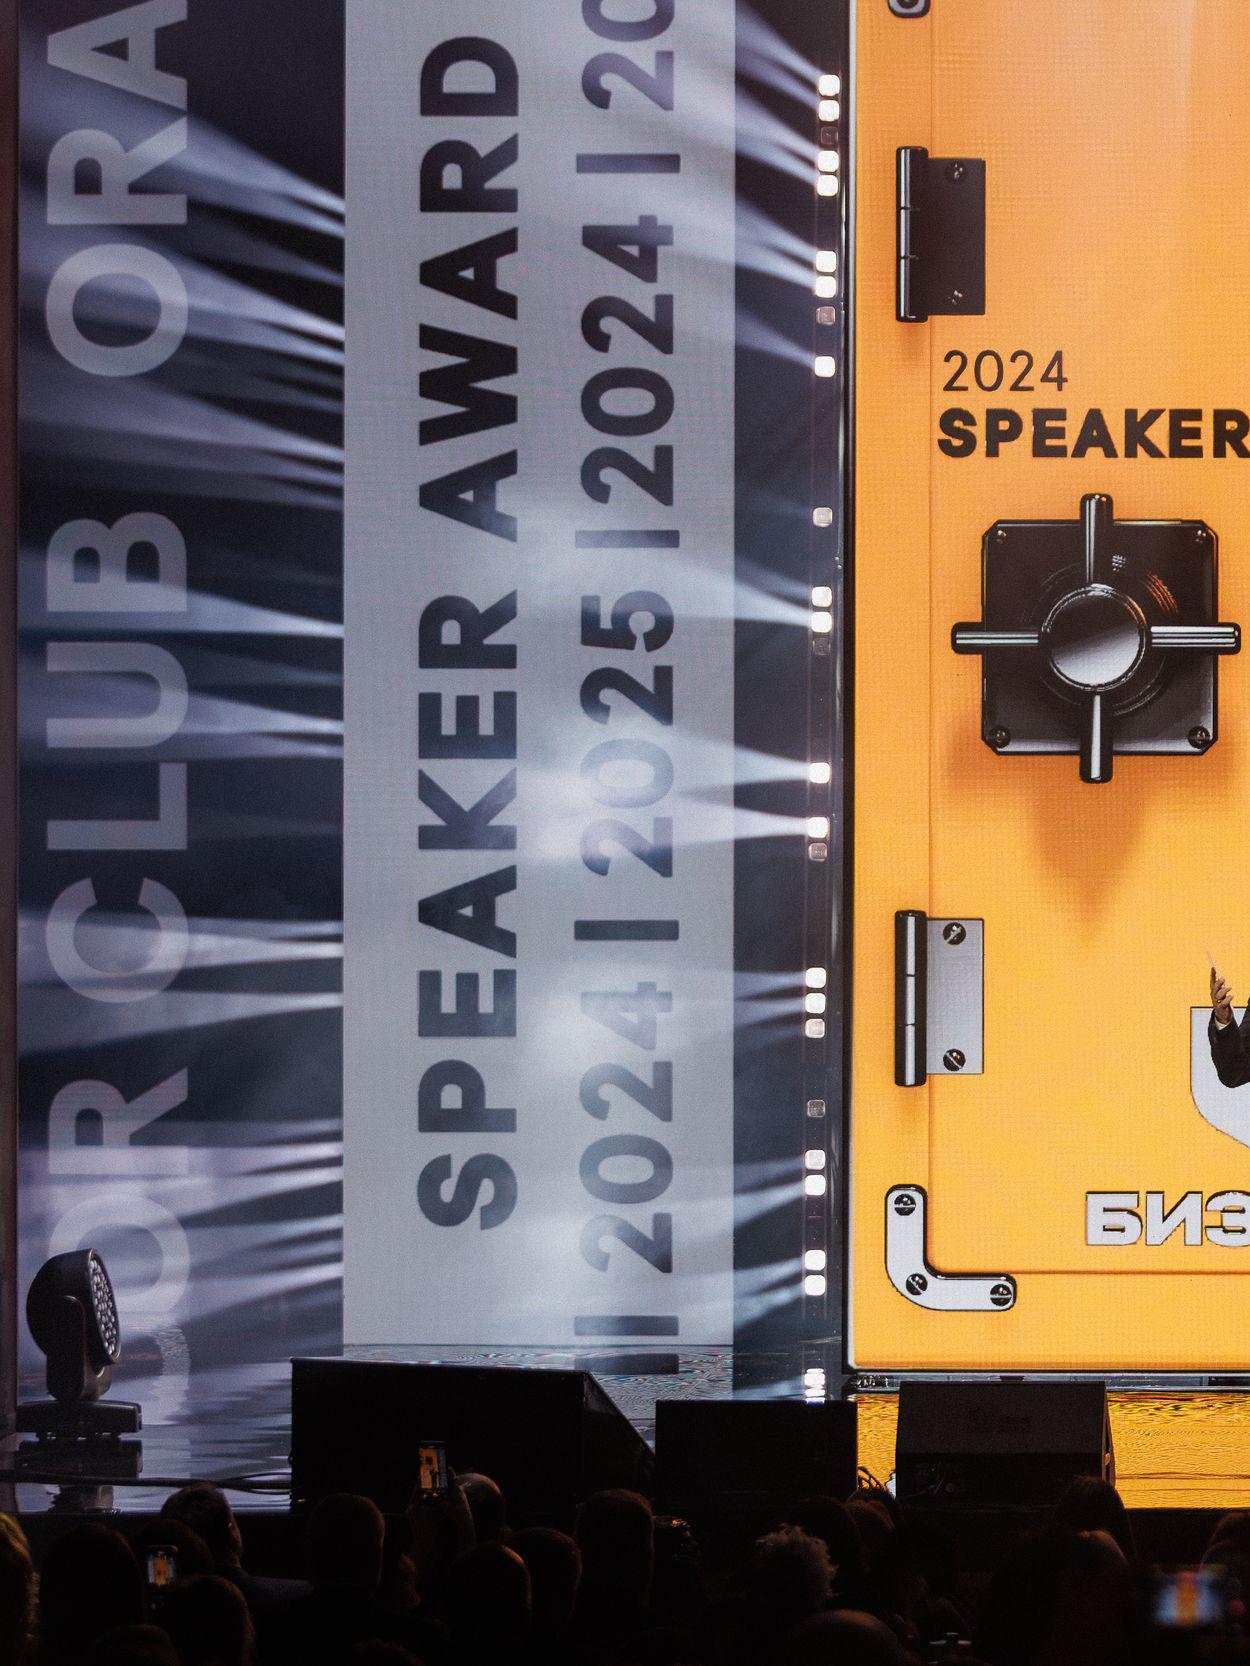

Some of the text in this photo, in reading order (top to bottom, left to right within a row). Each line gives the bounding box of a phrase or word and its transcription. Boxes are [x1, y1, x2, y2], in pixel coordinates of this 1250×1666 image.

[46, 0, 188, 377] ORA
[580, 214, 675, 508] 2024
[942, 350, 1069, 392] 2024
[46, 511, 189, 1003] CLUB
[418, 36, 518, 1231] SPEAKER AWARD
[580, 591, 675, 879] 2025
[579, 980, 674, 1274] 2024
